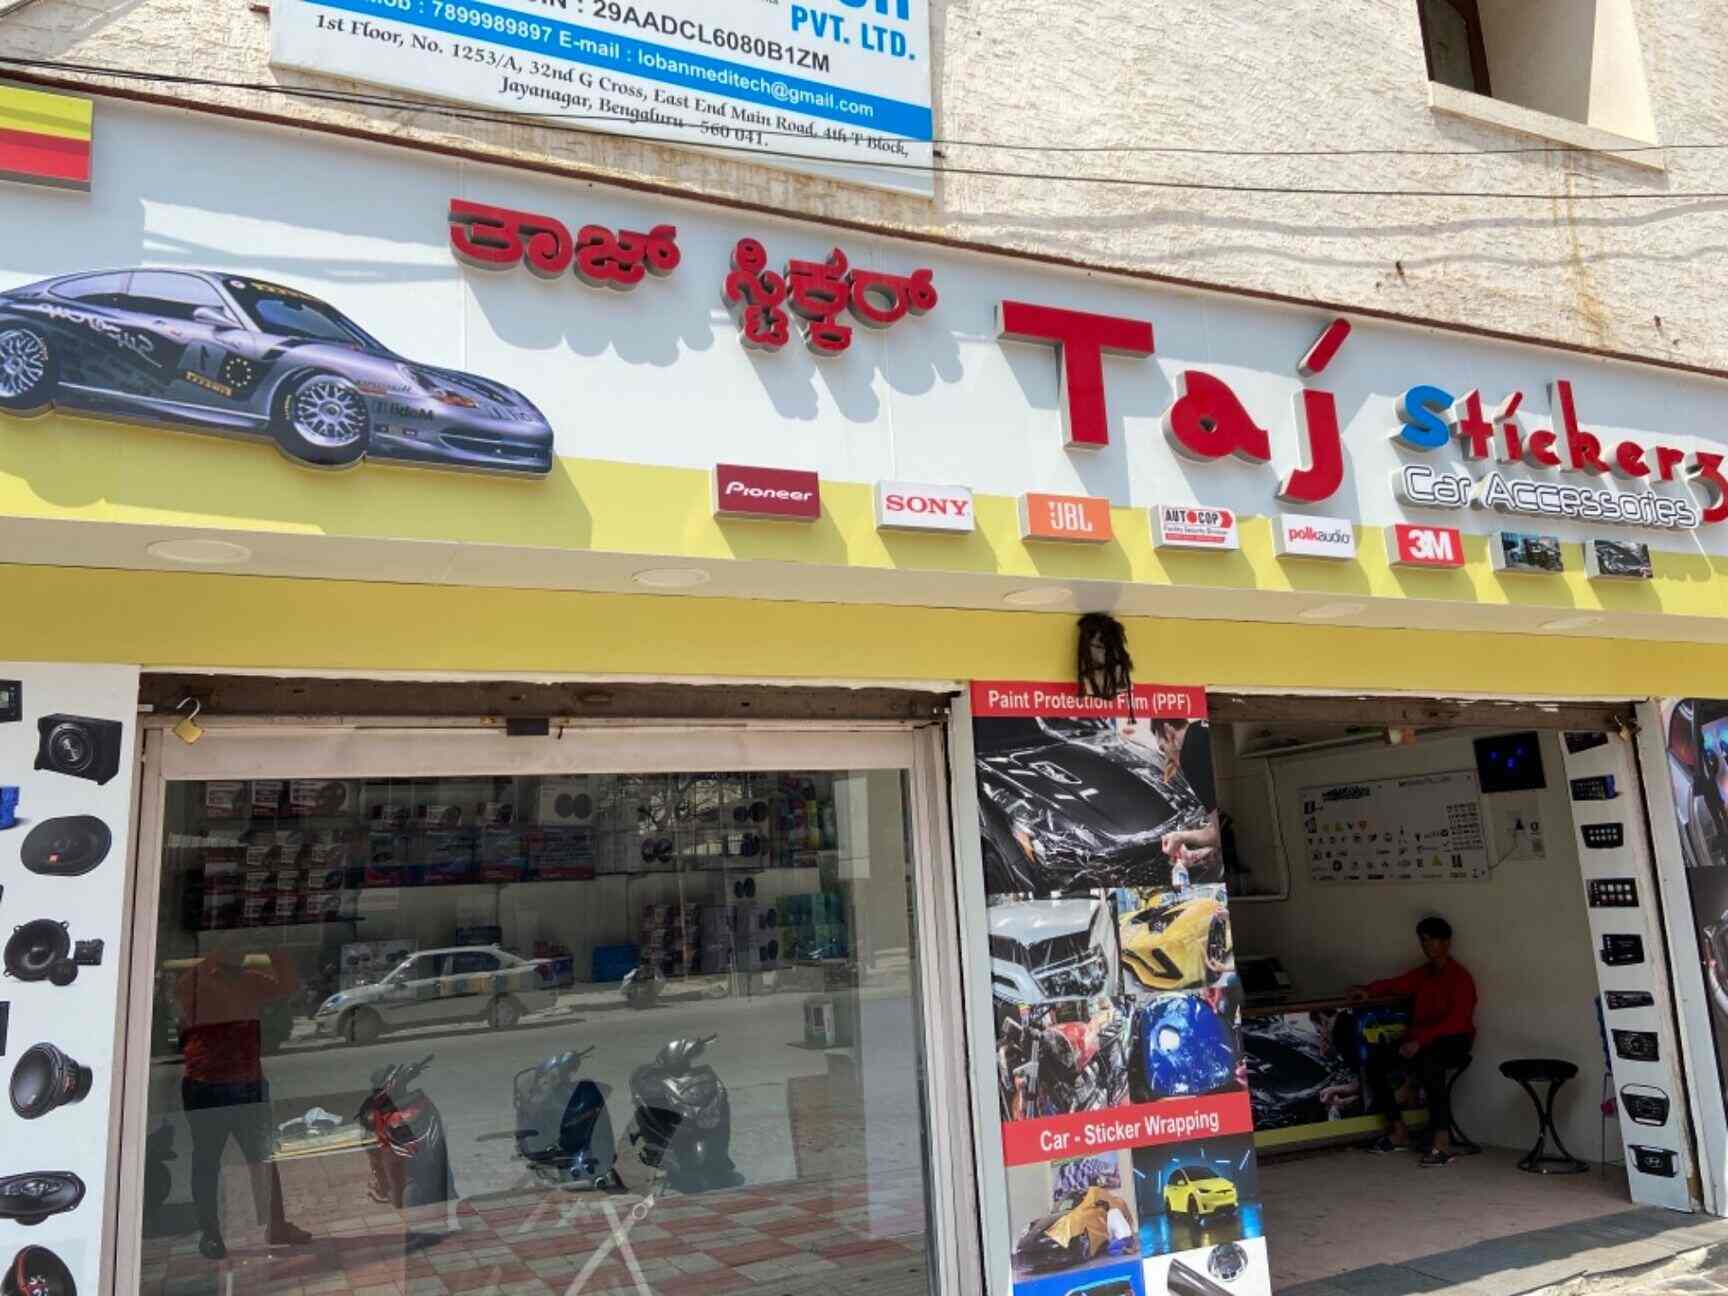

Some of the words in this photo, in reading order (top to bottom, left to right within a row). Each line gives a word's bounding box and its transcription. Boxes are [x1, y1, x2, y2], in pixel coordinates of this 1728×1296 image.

[593, 1, 830, 72] 29AADCL6080B1ZM
[791, 4, 849, 45] PVT.
[861, 23, 915, 61] LTD.
[315, 13, 344, 32] 1st
[352, 21, 404, 48] Floor,
[412, 36, 443, 54] No.
[453, 44, 522, 73] 1253/A,
[529, 62, 573, 83] 32nd
[579, 72, 593, 88] G
[600, 76, 648, 101] Cross,
[653, 87, 690, 109] East
[695, 97, 728, 118] End
[731, 105, 771, 126] Main
[432, 0, 553, 43] 7899989897
[559, 31, 620, 60] E-mail
[638, 49, 874, 118] lobanmeditech@gmail.com
[498, 76, 593, 111] Jayanagar,
[600, 98, 684, 128] Bengaluru
[998, 299, 1352, 504] Taj
[725, 480, 813, 502] Pioneer
[885, 494, 968, 517] SONY
[1047, 501, 1094, 532] JBL
[1402, 465, 1472, 507] Car
[1485, 472, 1699, 529] Accessories
[1407, 529, 1454, 561] 3M
[987, 689, 1030, 709] Paint
[1153, 692, 1192, 714] (PPF)
[1039, 1130, 1070, 1152] Car
[1084, 1120, 1141, 1145] Sticker
[1144, 1110, 1220, 1137] Wrapping
